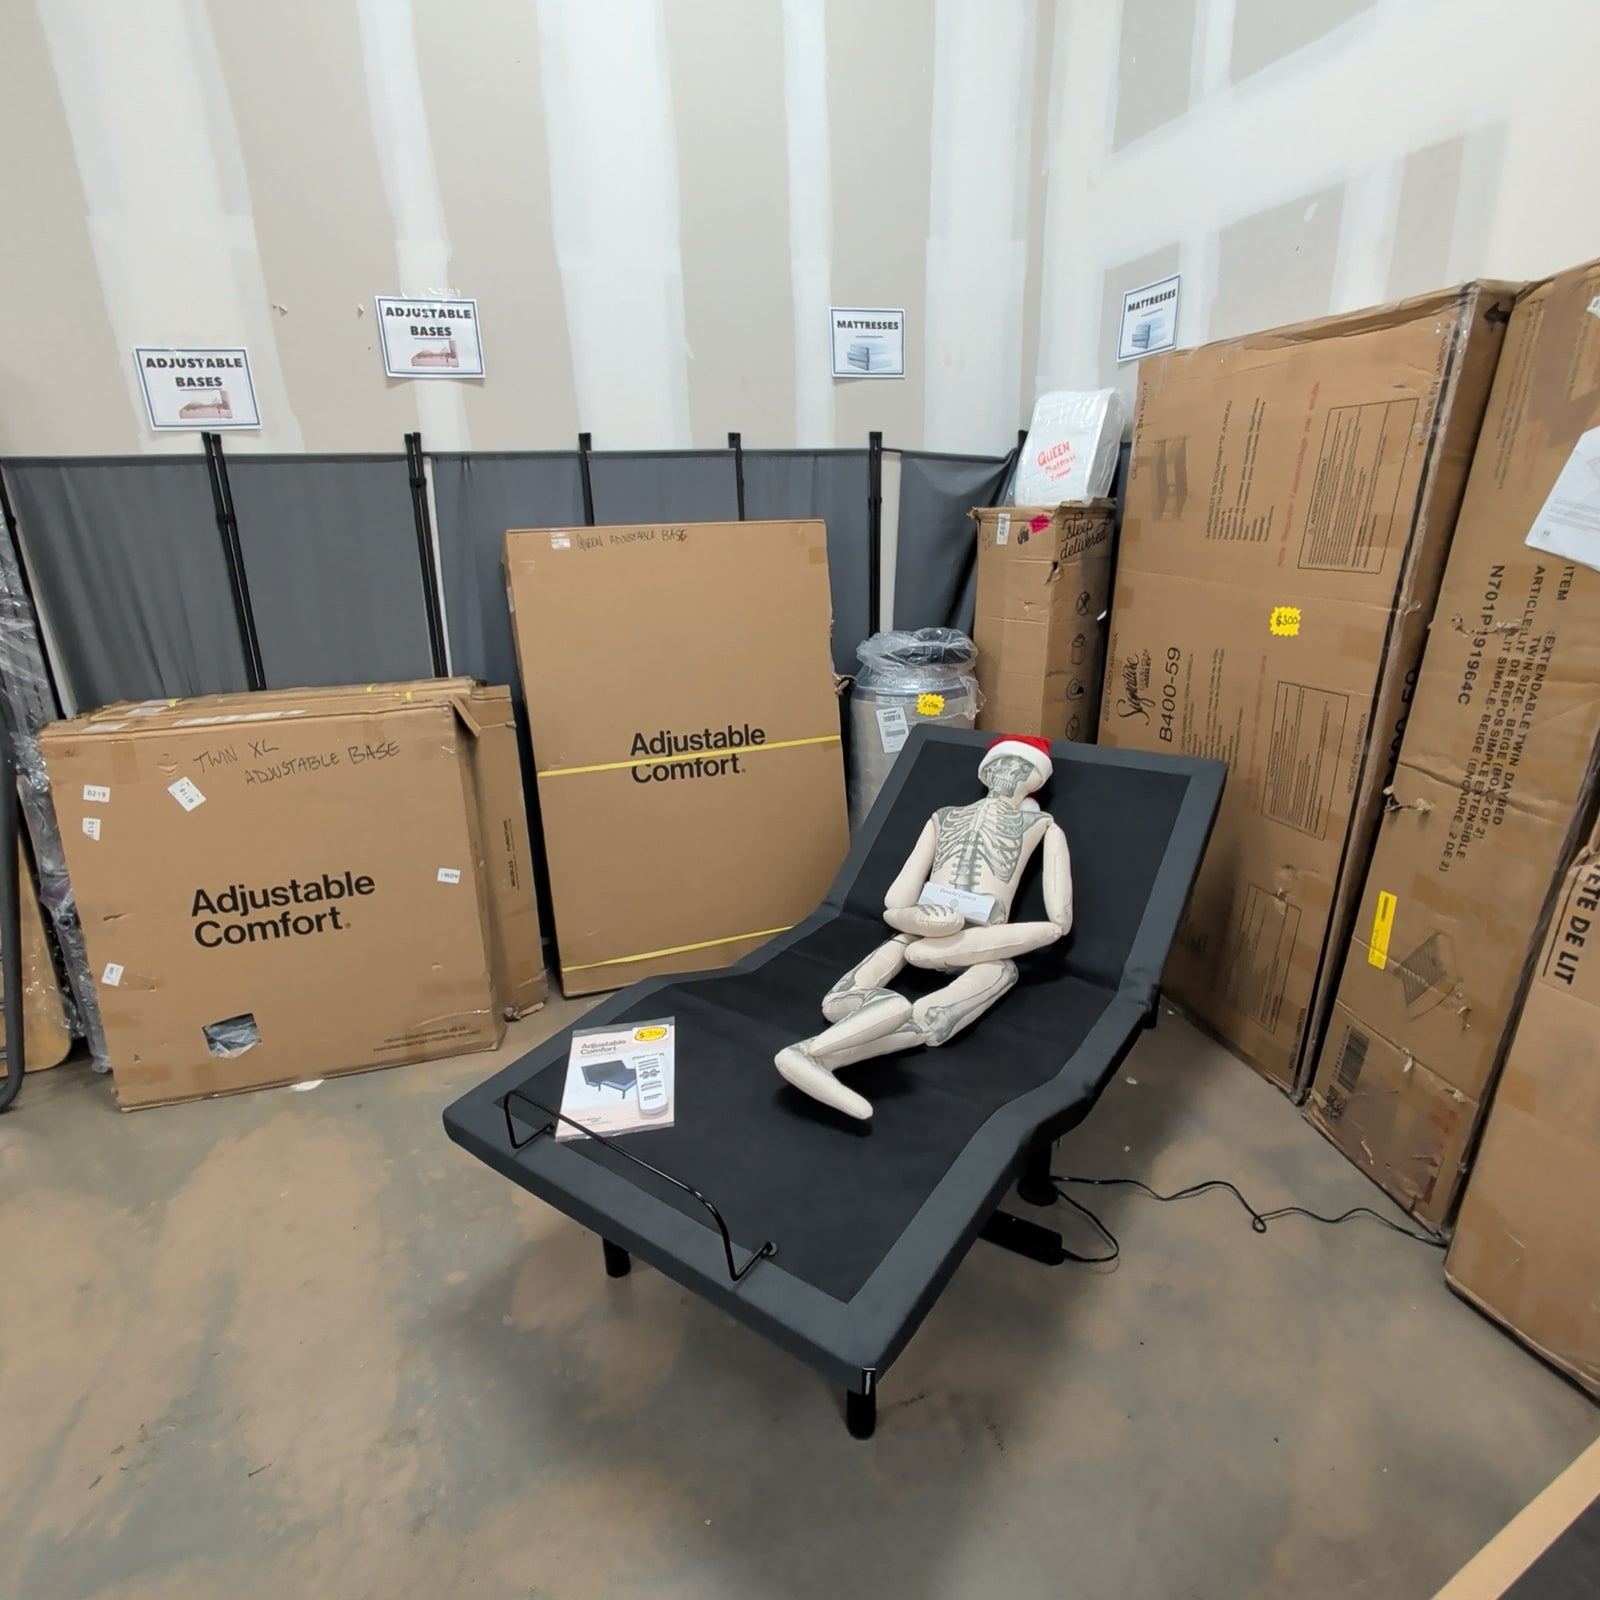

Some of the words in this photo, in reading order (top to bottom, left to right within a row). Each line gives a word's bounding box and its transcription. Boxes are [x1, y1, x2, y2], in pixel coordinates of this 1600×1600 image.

[385, 306, 472, 319] ADJUSTABLE
[1127, 288, 1176, 313] MATTRESSES
[410, 325, 452, 337] BASES
[836, 320, 899, 330] MATTRESSES
[145, 357, 243, 368] ADJUSTABLE
[175, 376, 223, 388] BASES
[1038, 441, 1070, 467] QUEEN
[1556, 565, 1576, 601] ITEM
[1507, 658, 1521, 678] DE
[1520, 635, 1543, 672] TWIN
[1116, 652, 1157, 727] Signature
[1158, 646, 1181, 743] B400-59
[1492, 680, 1516, 727] REPOS
[1511, 673, 1531, 705] SIZE
[629, 724, 766, 758] Adjustable
[1471, 713, 1492, 755] BEIGE
[1495, 717, 1517, 761] BEIGE
[1506, 732, 1527, 767] TWIN
[193, 745, 239, 774] TWIN
[248, 739, 280, 759] XL
[244, 752, 340, 785] ADJUSTABLE
[348, 741, 402, 765] BASE
[631, 753, 741, 785] Comfort
[1477, 728, 1501, 778] SIMPLE
[1479, 806, 1492, 826] OF
[1492, 772, 1516, 827] DAYBED
[1455, 780, 1486, 859] EXTENSIBLE
[1443, 841, 1456, 859] DE
[191, 871, 376, 917] Adjustable
[194, 905, 344, 948] Comfort
[1565, 915, 1592, 948] DE
[1553, 950, 1580, 986] LIT
[580, 1046, 617, 1055] Comfort
[581, 1039, 627, 1050] Adjustable
